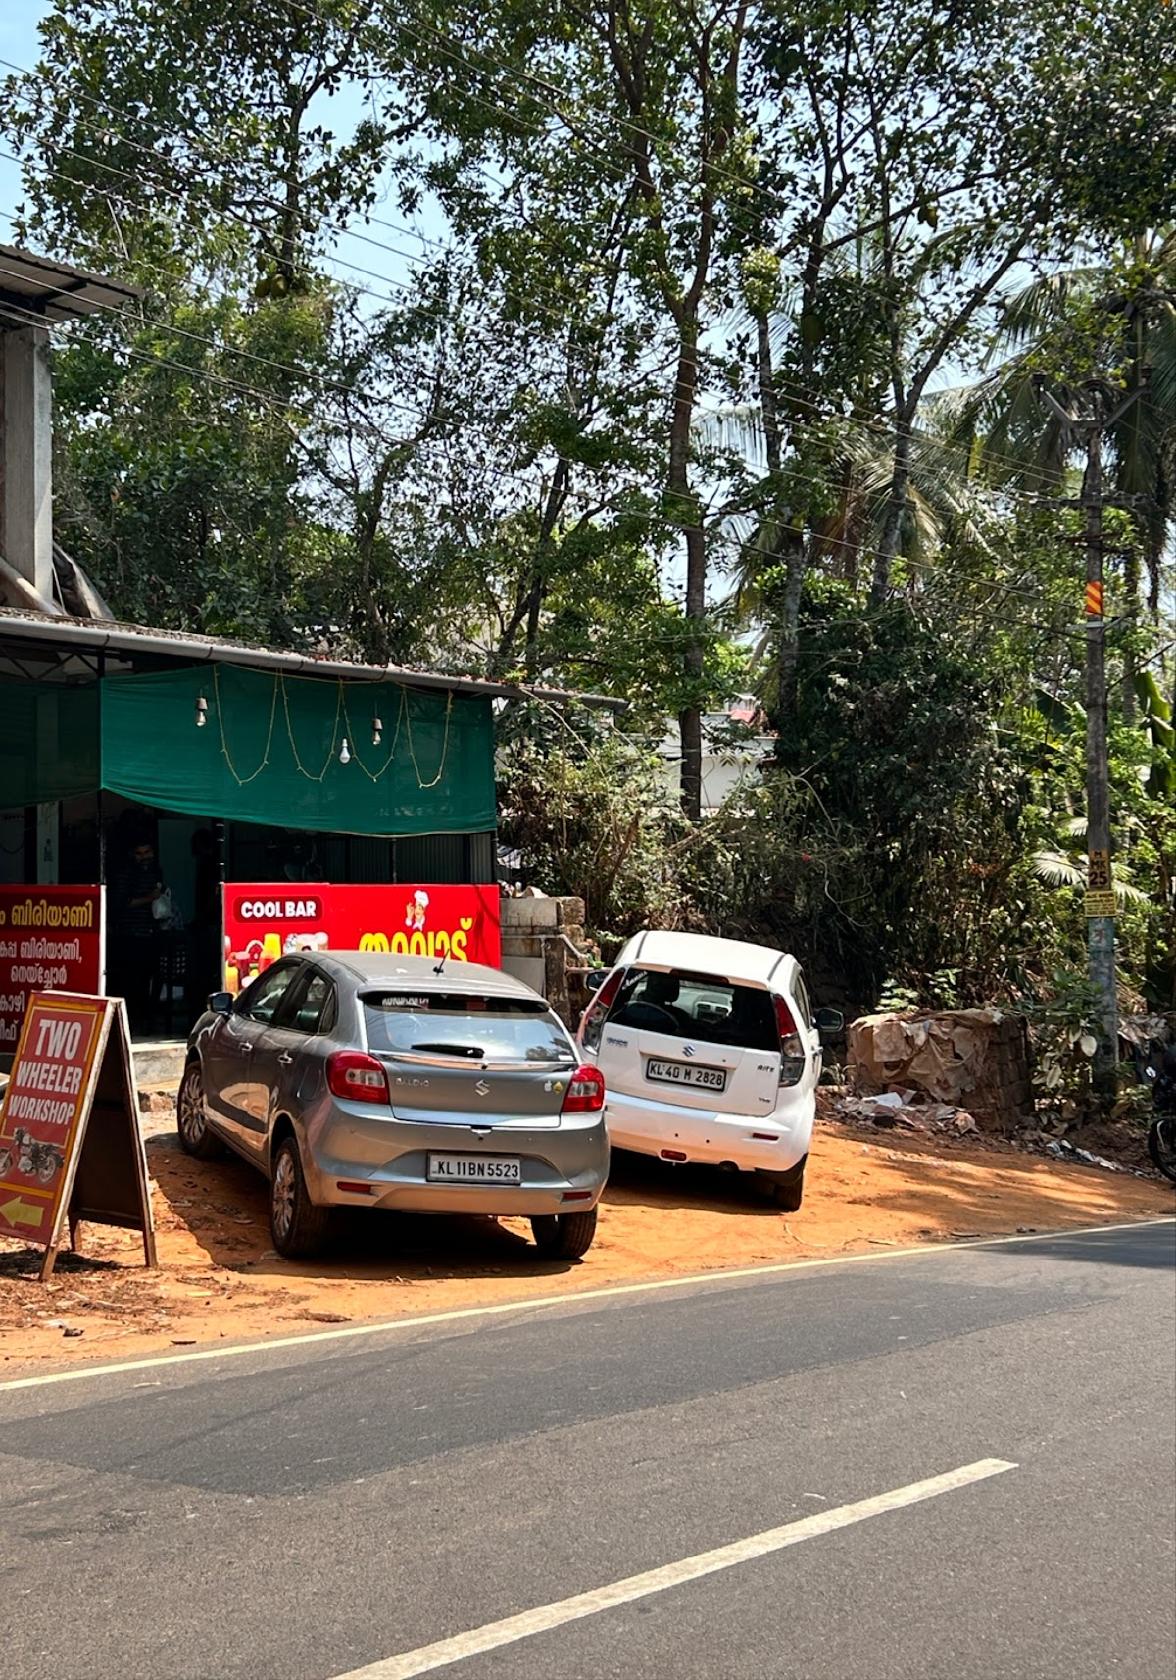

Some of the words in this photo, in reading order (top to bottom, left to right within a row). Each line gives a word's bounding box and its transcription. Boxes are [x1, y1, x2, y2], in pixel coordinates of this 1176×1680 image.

[1089, 871, 1108, 886] 25
[12, 898, 93, 928] ബിരിയാണി
[241, 901, 283, 918] COOL
[285, 901, 317, 918] BAR
[34, 1018, 82, 1061] TWO
[16, 1060, 83, 1095] WHEELER
[649, 1063, 663, 1076] KL
[695, 1071, 723, 1086] 2828
[8, 1094, 75, 1126] WORKSHOP
